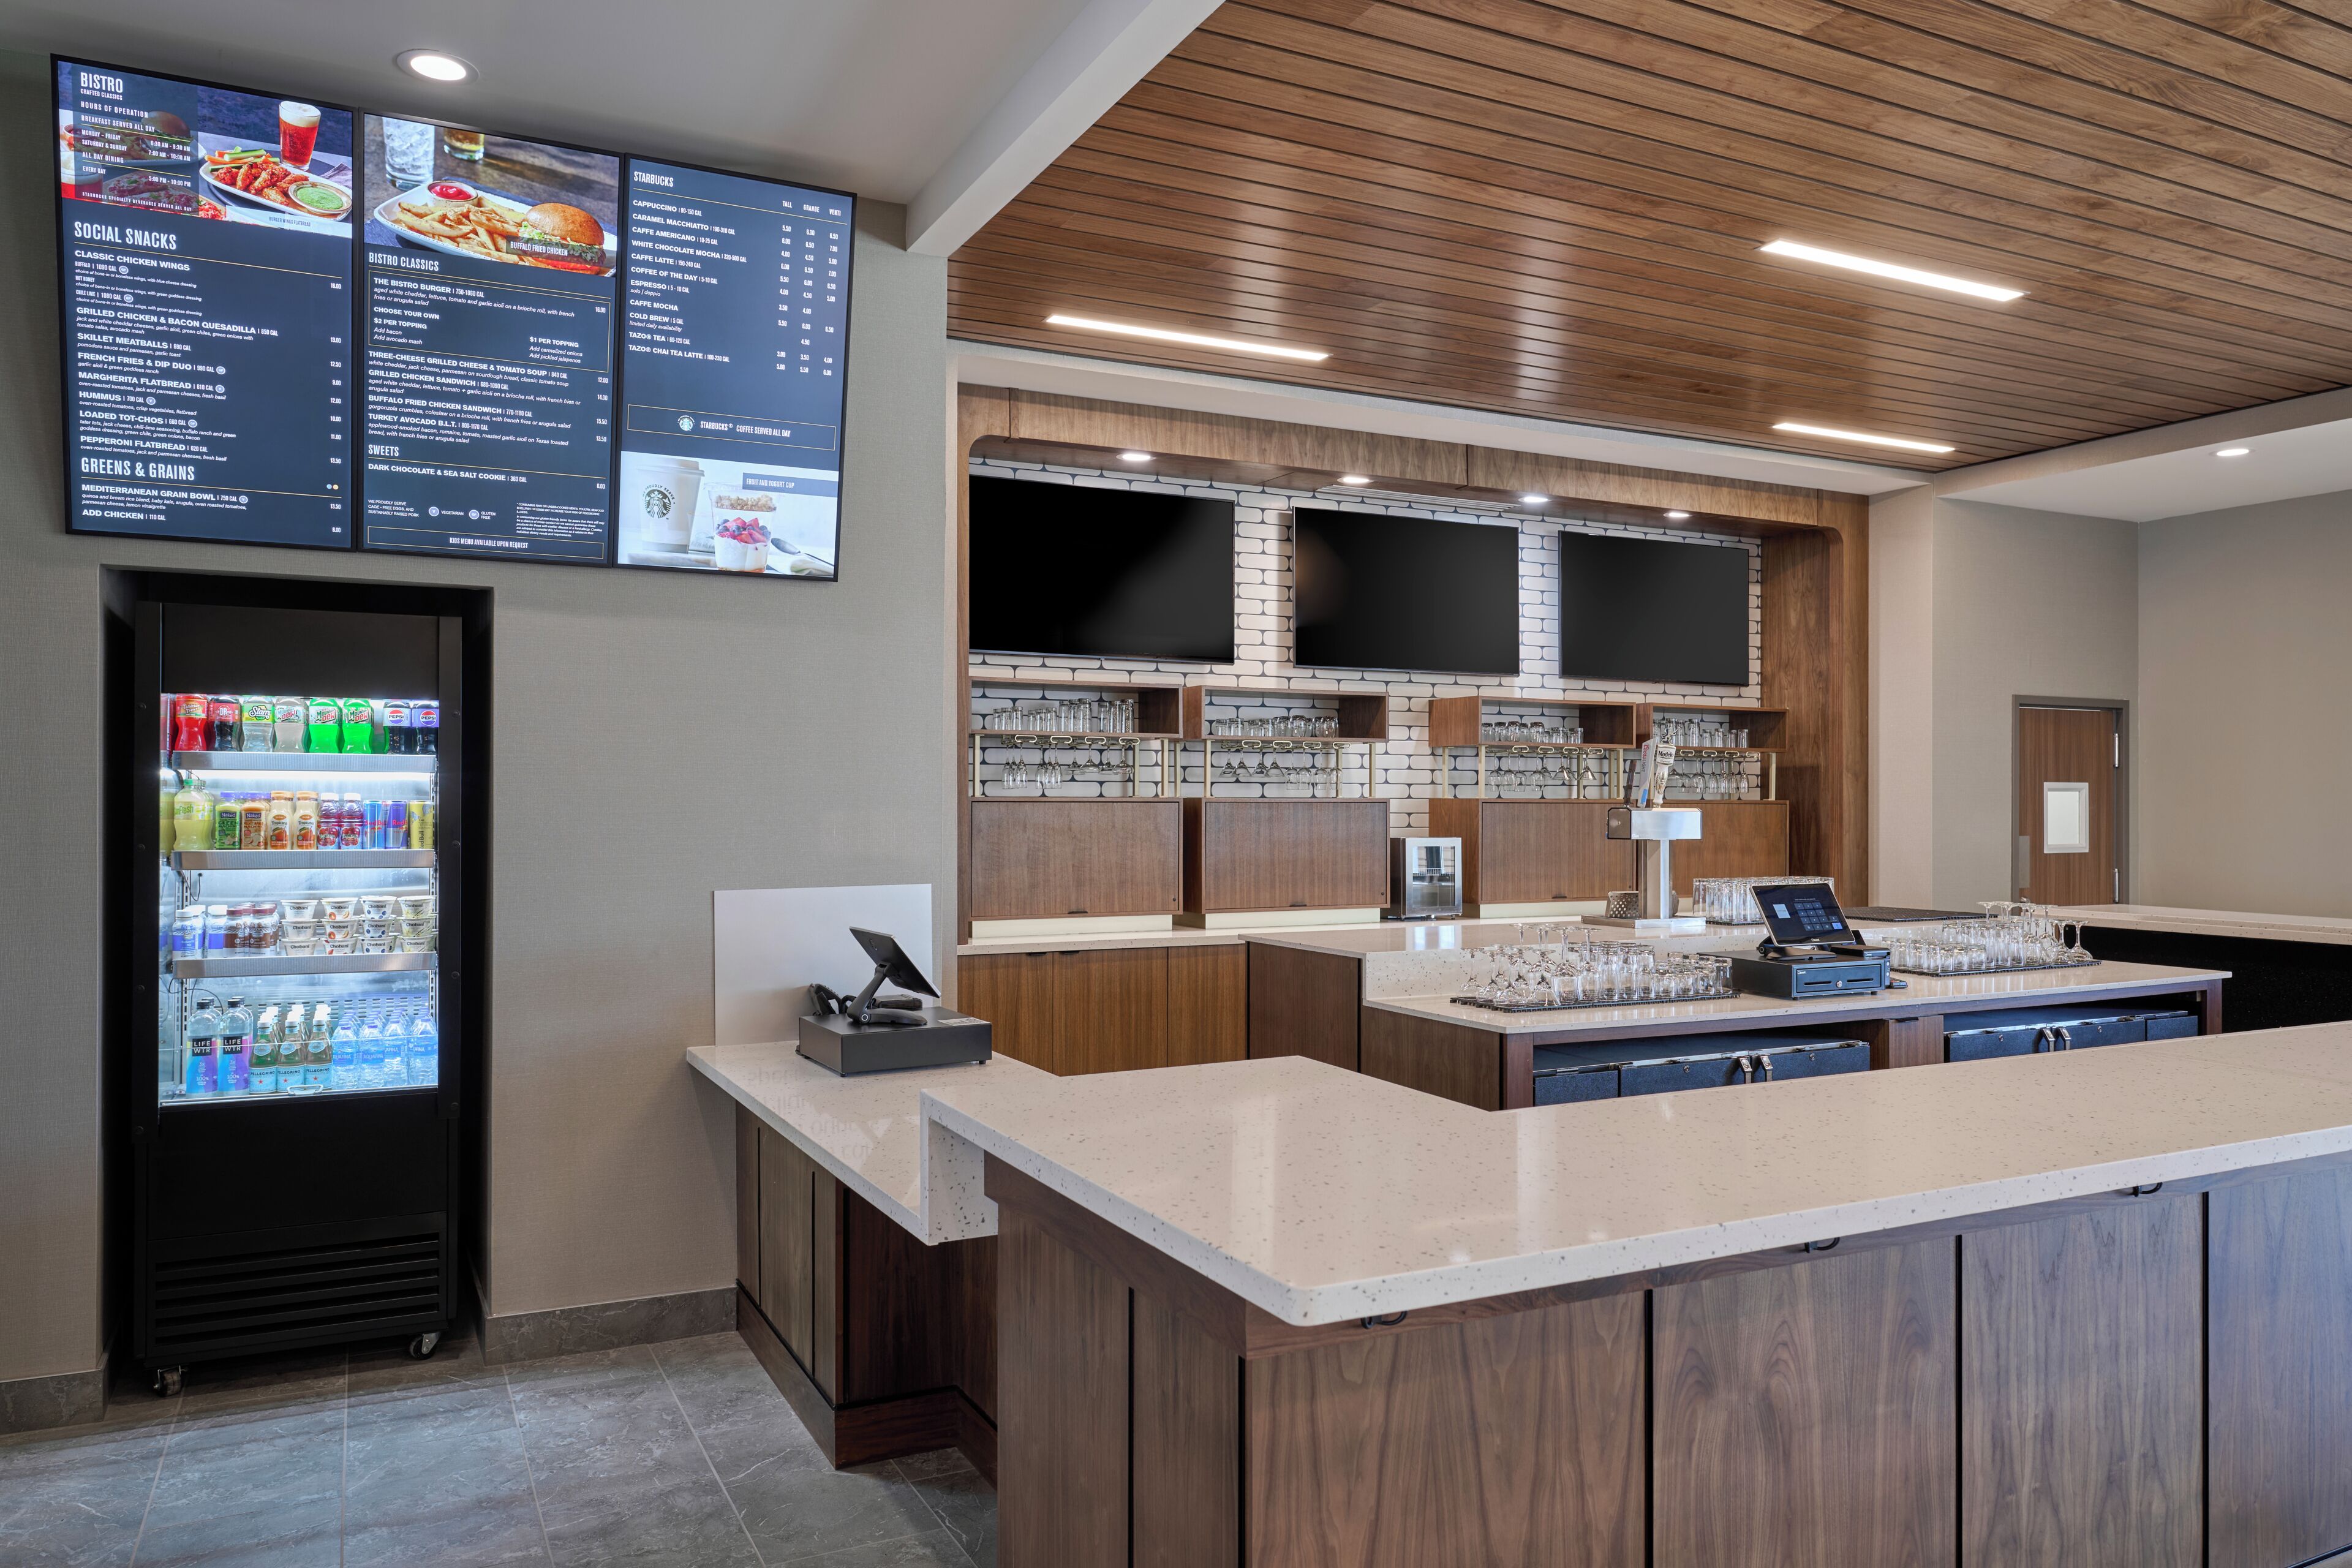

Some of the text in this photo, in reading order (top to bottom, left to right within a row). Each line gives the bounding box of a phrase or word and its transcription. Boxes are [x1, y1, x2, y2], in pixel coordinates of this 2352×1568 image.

[80, 72, 123, 93] BISTRO
[80, 88, 123, 100] CRAFTED CLASSICS
[80, 100, 102, 111] HOURS
[114, 107, 148, 118] OPERATION
[81, 115, 111, 126] BREAKFAST
[112, 120, 133, 129] SERVED
[633, 171, 674, 187] STARBUCKS
[633, 200, 677, 212] CAPPUCCINO
[803, 204, 820, 213] GRANDE
[632, 213, 709, 230] CARAMEL MACCHIATTO
[74, 221, 176, 250] SOCIAL SNACKS
[510, 241, 568, 257] BUFFALO FRIED CHICKEN
[631, 239, 721, 259] WHITE CHOCOLATE MOCHA
[75, 250, 190, 271] CLASSIC CHICKEN WINGS
[369, 252, 439, 271] BISTRO CLASSICS
[630, 266, 658, 276] COFFEE
[391, 279, 418, 289] BISTRO
[420, 284, 451, 293] BURGER
[630, 279, 667, 290] ESPRESSO
[374, 306, 402, 315] CHOOSE
[630, 299, 679, 311] CAFFE MOCHA
[77, 307, 115, 317] GRILLED
[117, 311, 157, 323] CHICKEN
[168, 317, 200, 328] BACON
[202, 322, 256, 334] QUESADILLA
[77, 333, 168, 349] SKILLET MEATBALLS
[78, 352, 115, 363] FRENCH
[118, 356, 145, 366] FRIES
[172, 362, 192, 371] DUO
[368, 350, 426, 363] THREE-CHEESE
[426, 357, 458, 366] GRILLED
[459, 361, 488, 370] CHEESE
[496, 365, 526, 374] TOMATO
[78, 371, 192, 389] MARGHERITA FLATBREAD
[368, 369, 476, 386] GRILLED CHICKEN SANDWICH
[79, 391, 121, 401] HUMMUS
[80, 410, 164, 424] LOADED TOT-CHOS
[368, 413, 399, 422] TURKEY
[399, 417, 437, 426] AVOCADO
[736, 424, 754, 434] COFFEE
[754, 426, 772, 435] SERVED
[80, 435, 186, 451] PEPPERONI FLATBREAD
[368, 444, 399, 457] SWEETS
[81, 457, 195, 481] GREENS & GRAINS
[391, 466, 435, 475] CHOCOLATE
[81, 484, 158, 496] MEDITERRANEAN
[160, 490, 188, 499] GRAIN
[664, 488, 675, 500] SERVE
[104, 511, 144, 519] CHICKEN
[248, 706, 271, 718] Starry
[174, 805, 194, 815] unFresh
